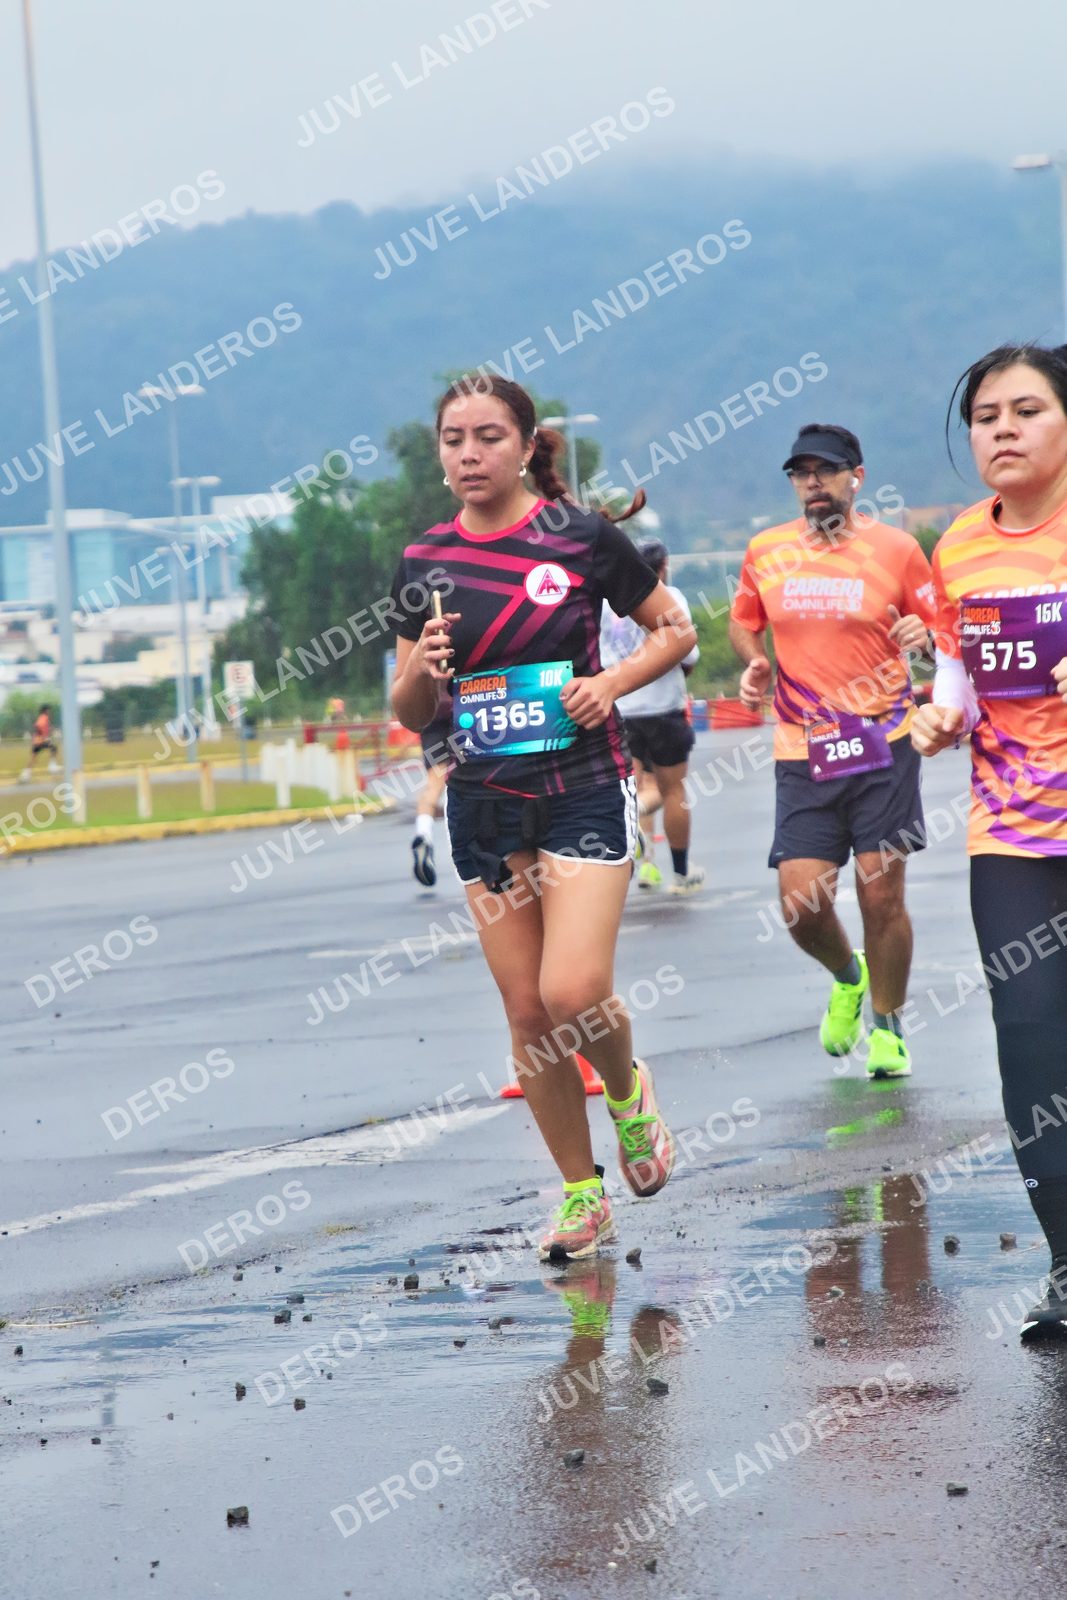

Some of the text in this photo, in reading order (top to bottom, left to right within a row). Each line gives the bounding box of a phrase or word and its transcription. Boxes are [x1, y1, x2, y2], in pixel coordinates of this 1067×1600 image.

[783, 577, 864, 600] CARRERA
[1035, 602, 1062, 624] 15K
[981, 641, 1037, 672] 575
[460, 676, 507, 695] CARRERA
[540, 669, 563, 688] 10K
[475, 701, 546, 732] 1365
[824, 737, 864, 762] 286
